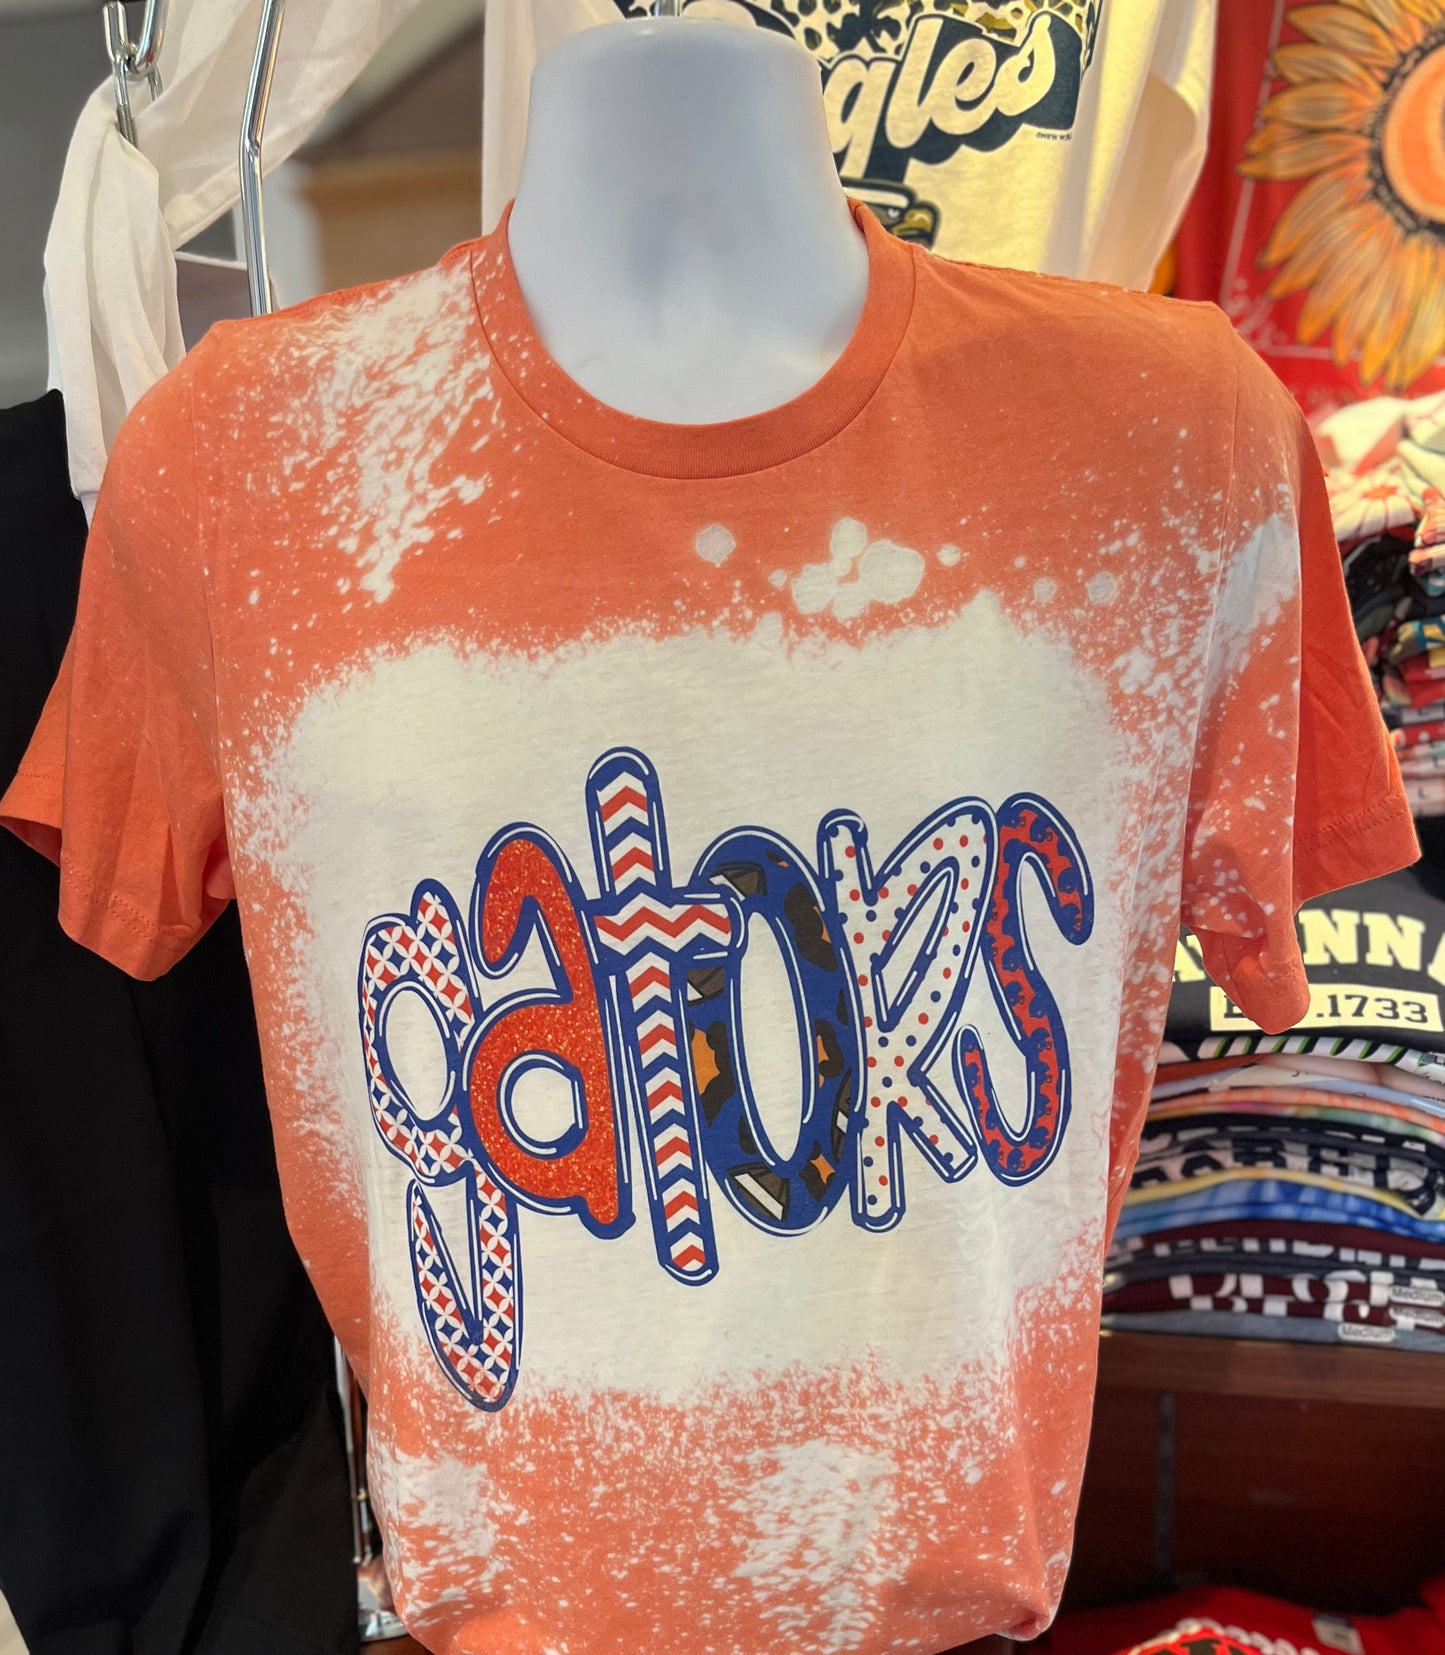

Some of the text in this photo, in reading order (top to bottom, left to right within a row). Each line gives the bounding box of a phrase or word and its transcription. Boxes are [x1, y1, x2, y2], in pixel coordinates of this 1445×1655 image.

[823, 14, 1056, 179] gles
[1392, 1286, 1442, 1302] Medium
[1342, 1325, 1392, 1339] Medium
